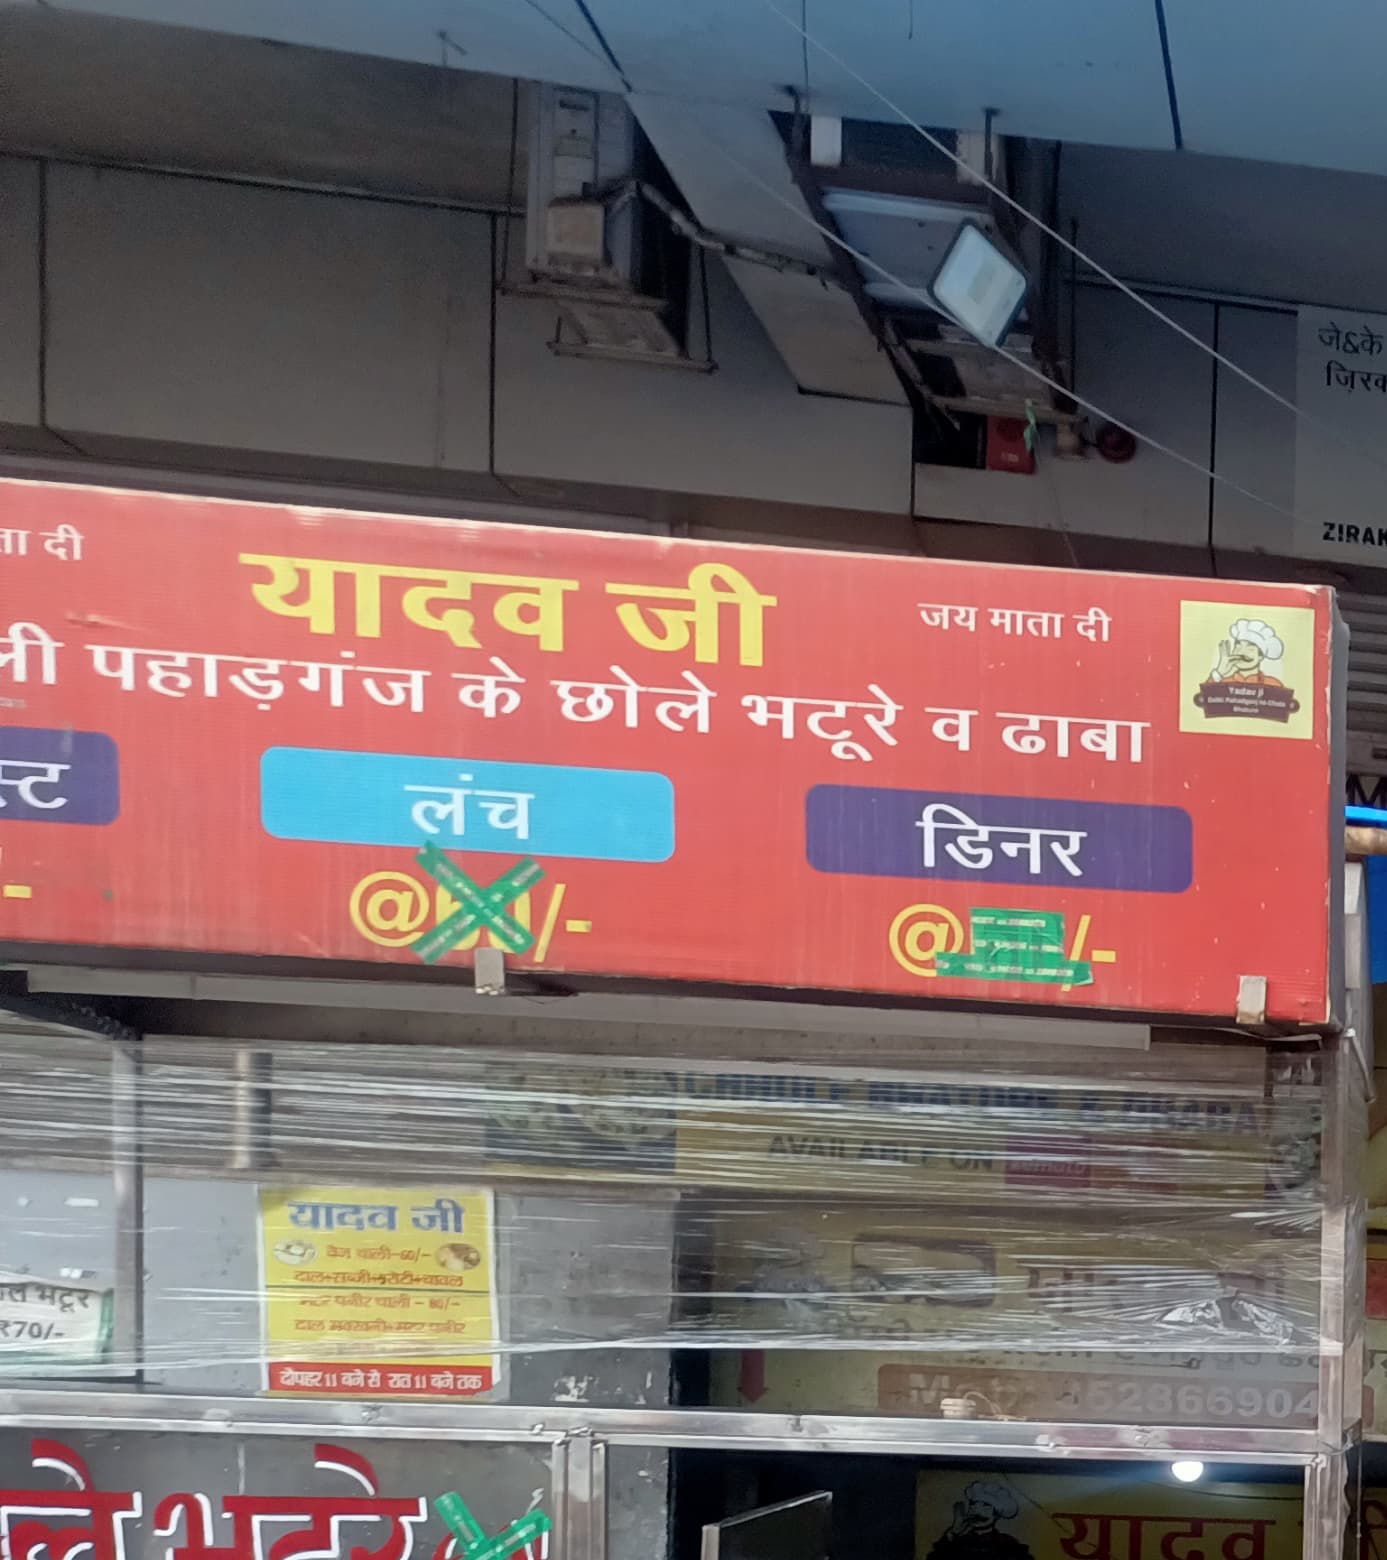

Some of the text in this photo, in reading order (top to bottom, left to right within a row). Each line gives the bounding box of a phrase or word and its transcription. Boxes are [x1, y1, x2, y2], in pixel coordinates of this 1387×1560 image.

[239, 552, 778, 669] यादव जी
[917, 602, 1112, 642] जय माता दी
[84, 643, 432, 713] पहाड़गंज
[452, 656, 527, 718] के
[550, 664, 717, 735] छोले
[741, 684, 904, 762] भटूरे
[925, 707, 979, 752] व
[995, 709, 1151, 763] ढाबा
[404, 772, 535, 840] लंच
[915, 802, 1088, 878] डिनर
[288, 1198, 466, 1234] यादव जी
